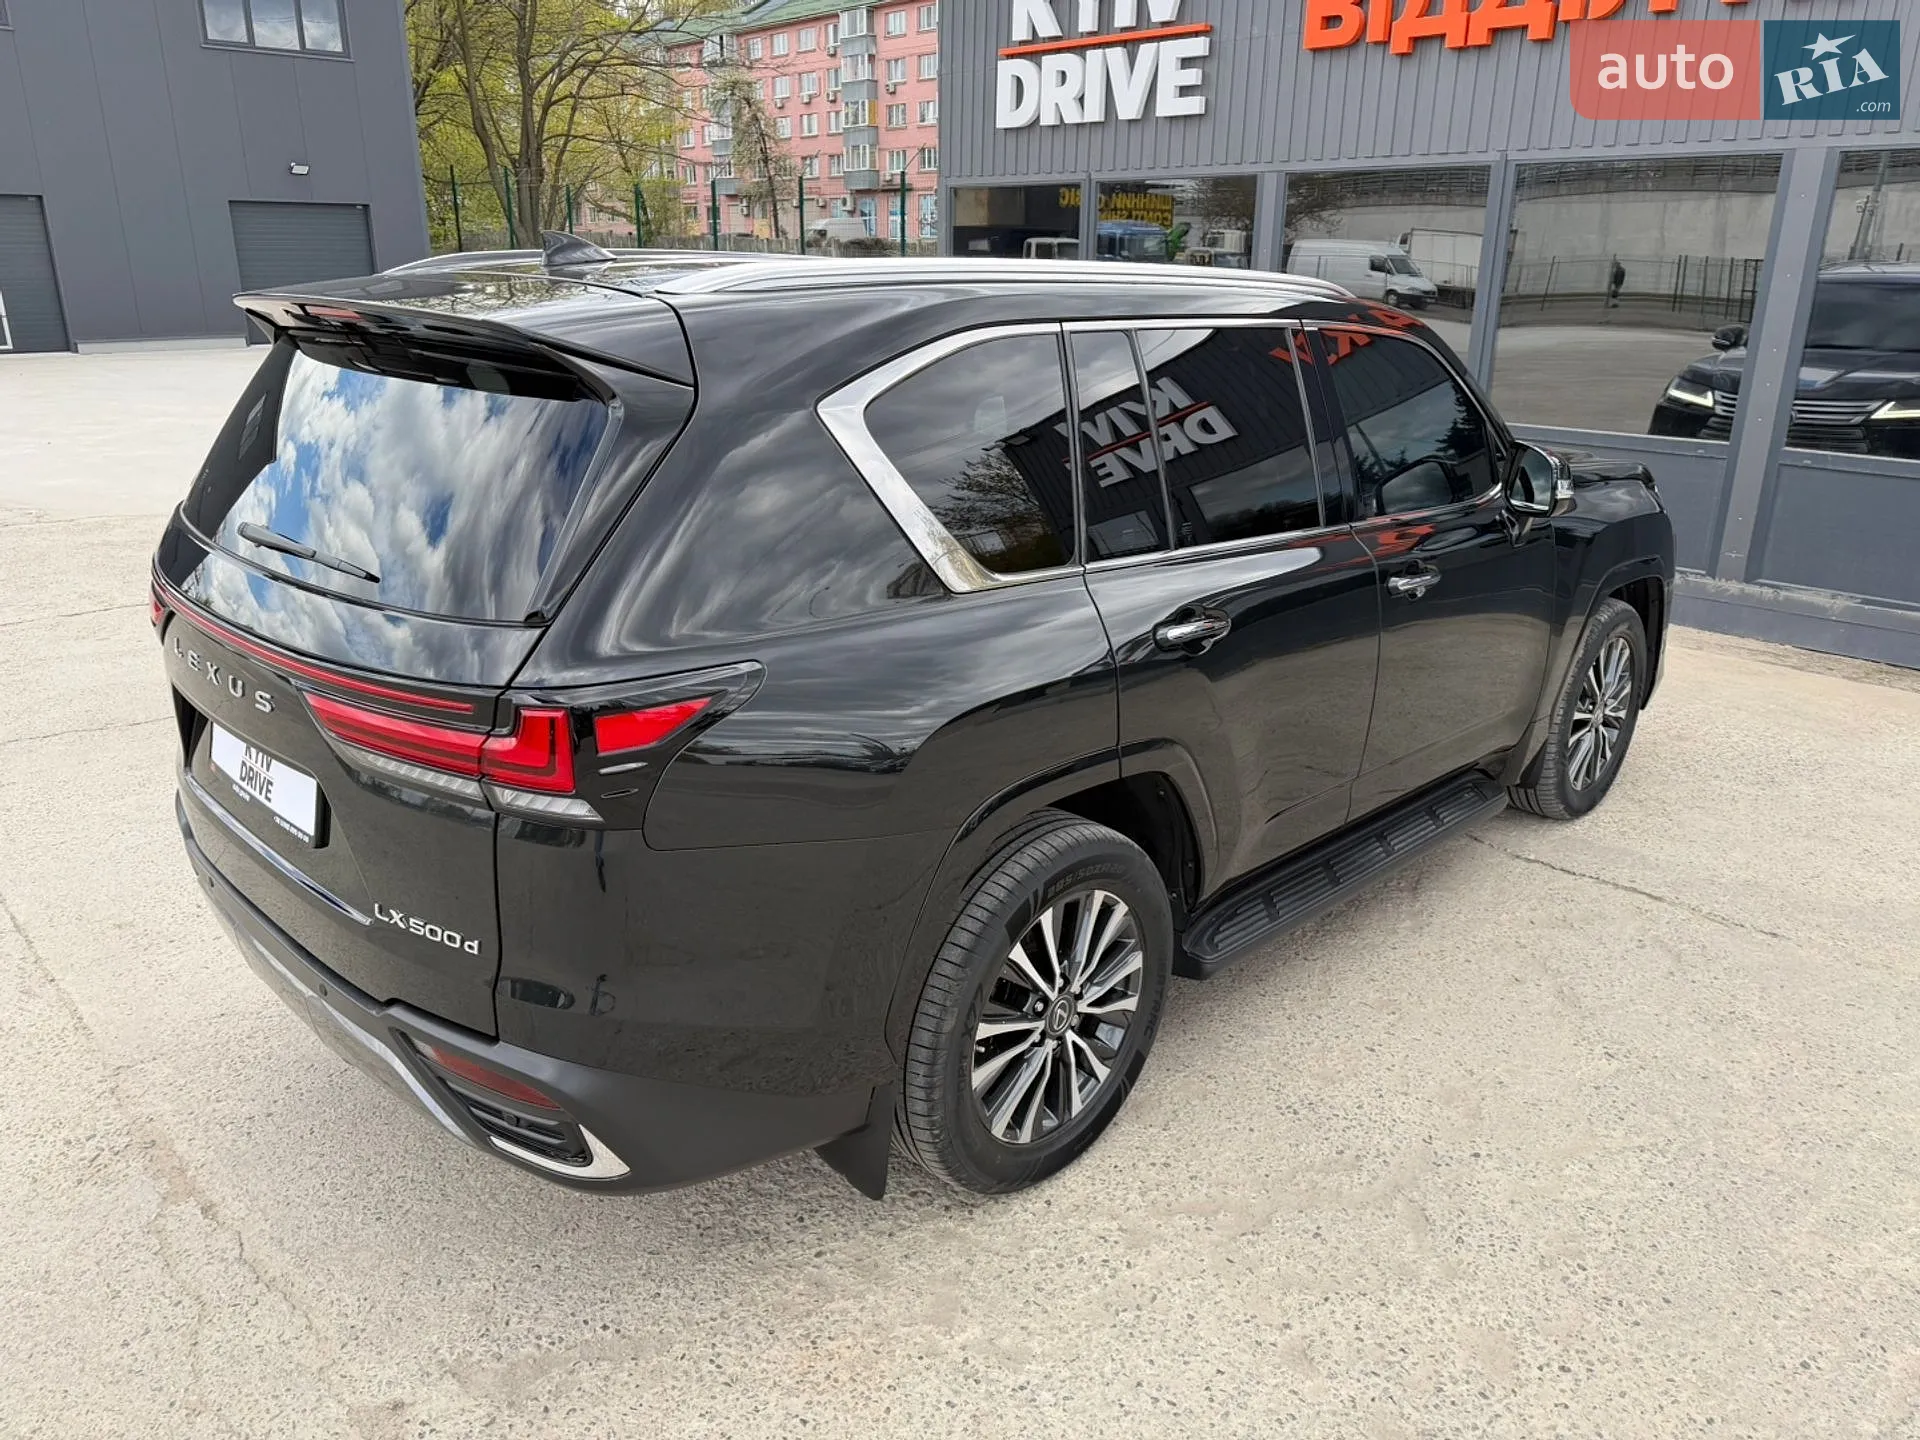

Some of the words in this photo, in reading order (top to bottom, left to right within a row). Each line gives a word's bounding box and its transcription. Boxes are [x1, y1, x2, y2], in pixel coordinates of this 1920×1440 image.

[996, 37, 1211, 129] DRIVE
[174, 637, 274, 713] LEXUS
[239, 760, 274, 803] DRIVE
